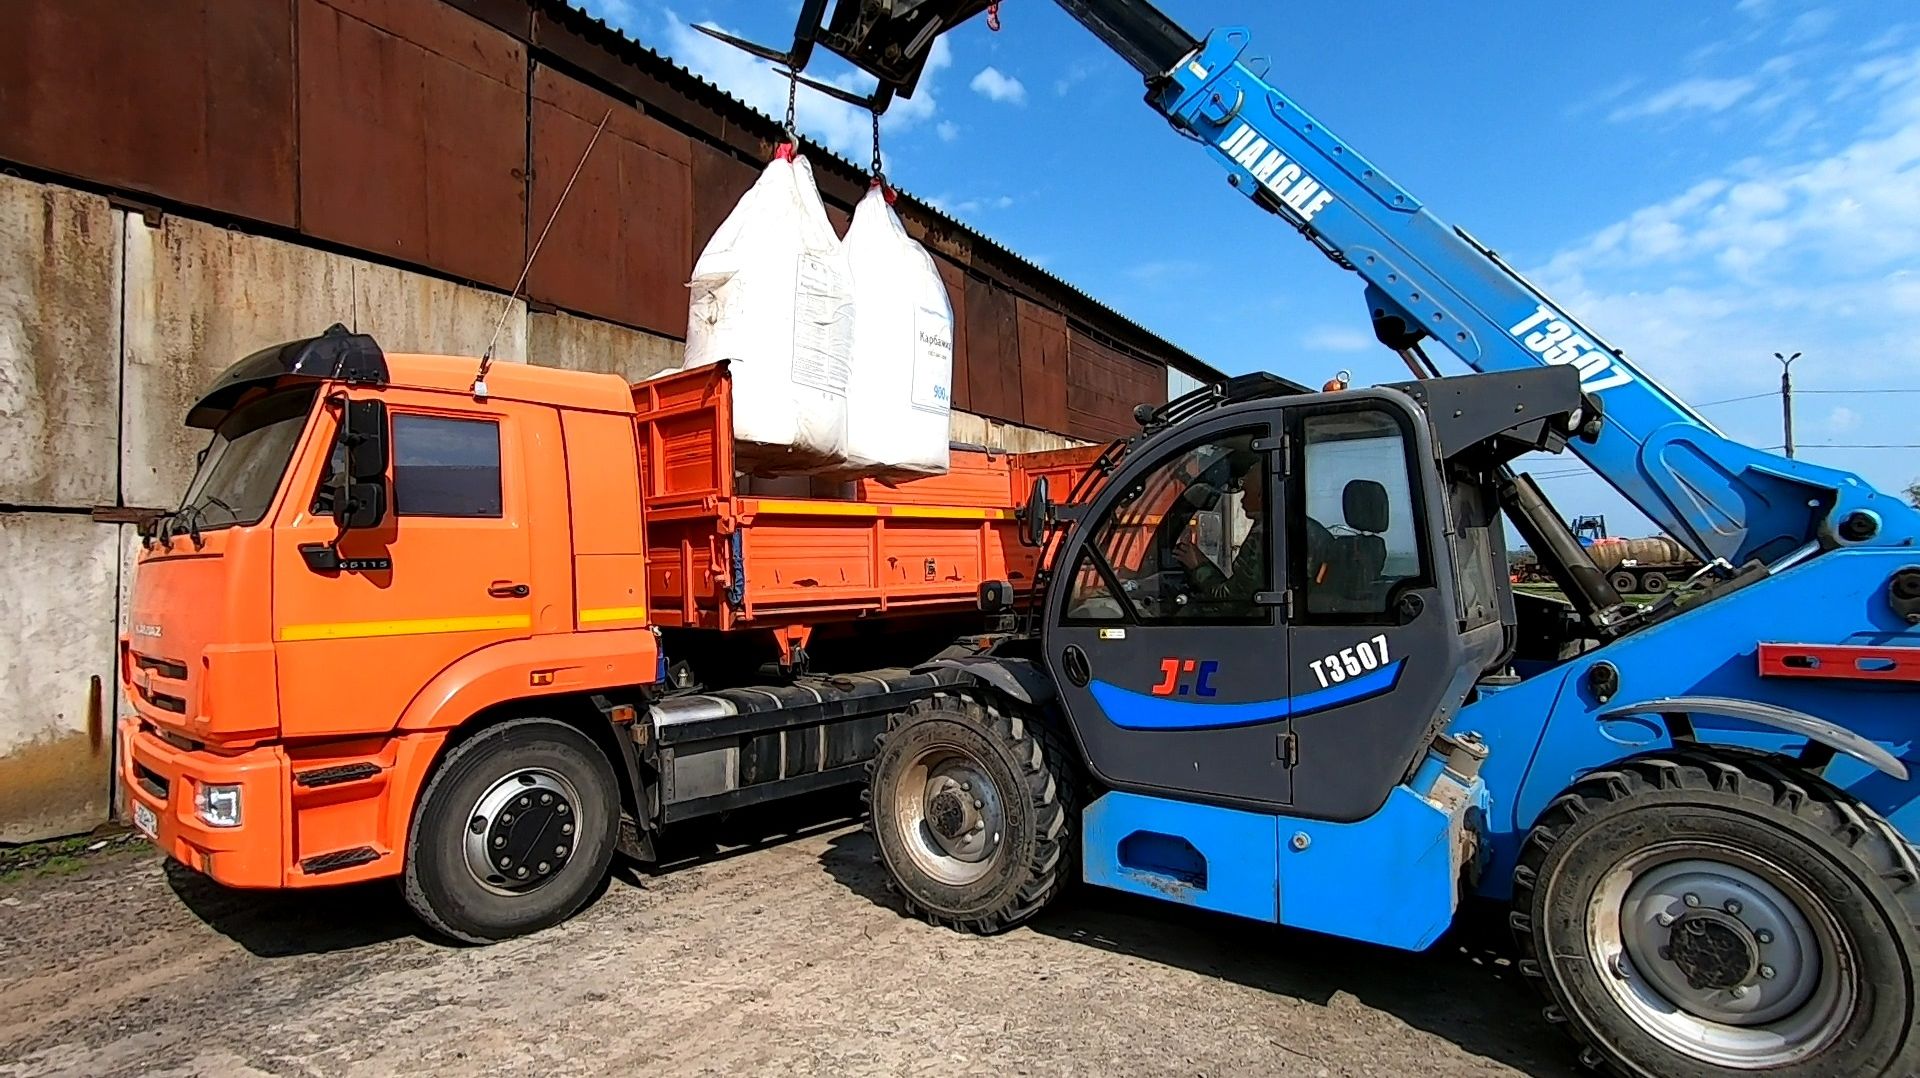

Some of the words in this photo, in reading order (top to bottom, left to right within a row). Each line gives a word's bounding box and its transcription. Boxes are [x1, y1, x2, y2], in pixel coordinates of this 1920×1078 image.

[1219, 122, 1334, 222] JIANGHE
[1509, 304, 1634, 394] T3507
[339, 560, 388, 569] 65115
[1309, 634, 1389, 687] T3507
